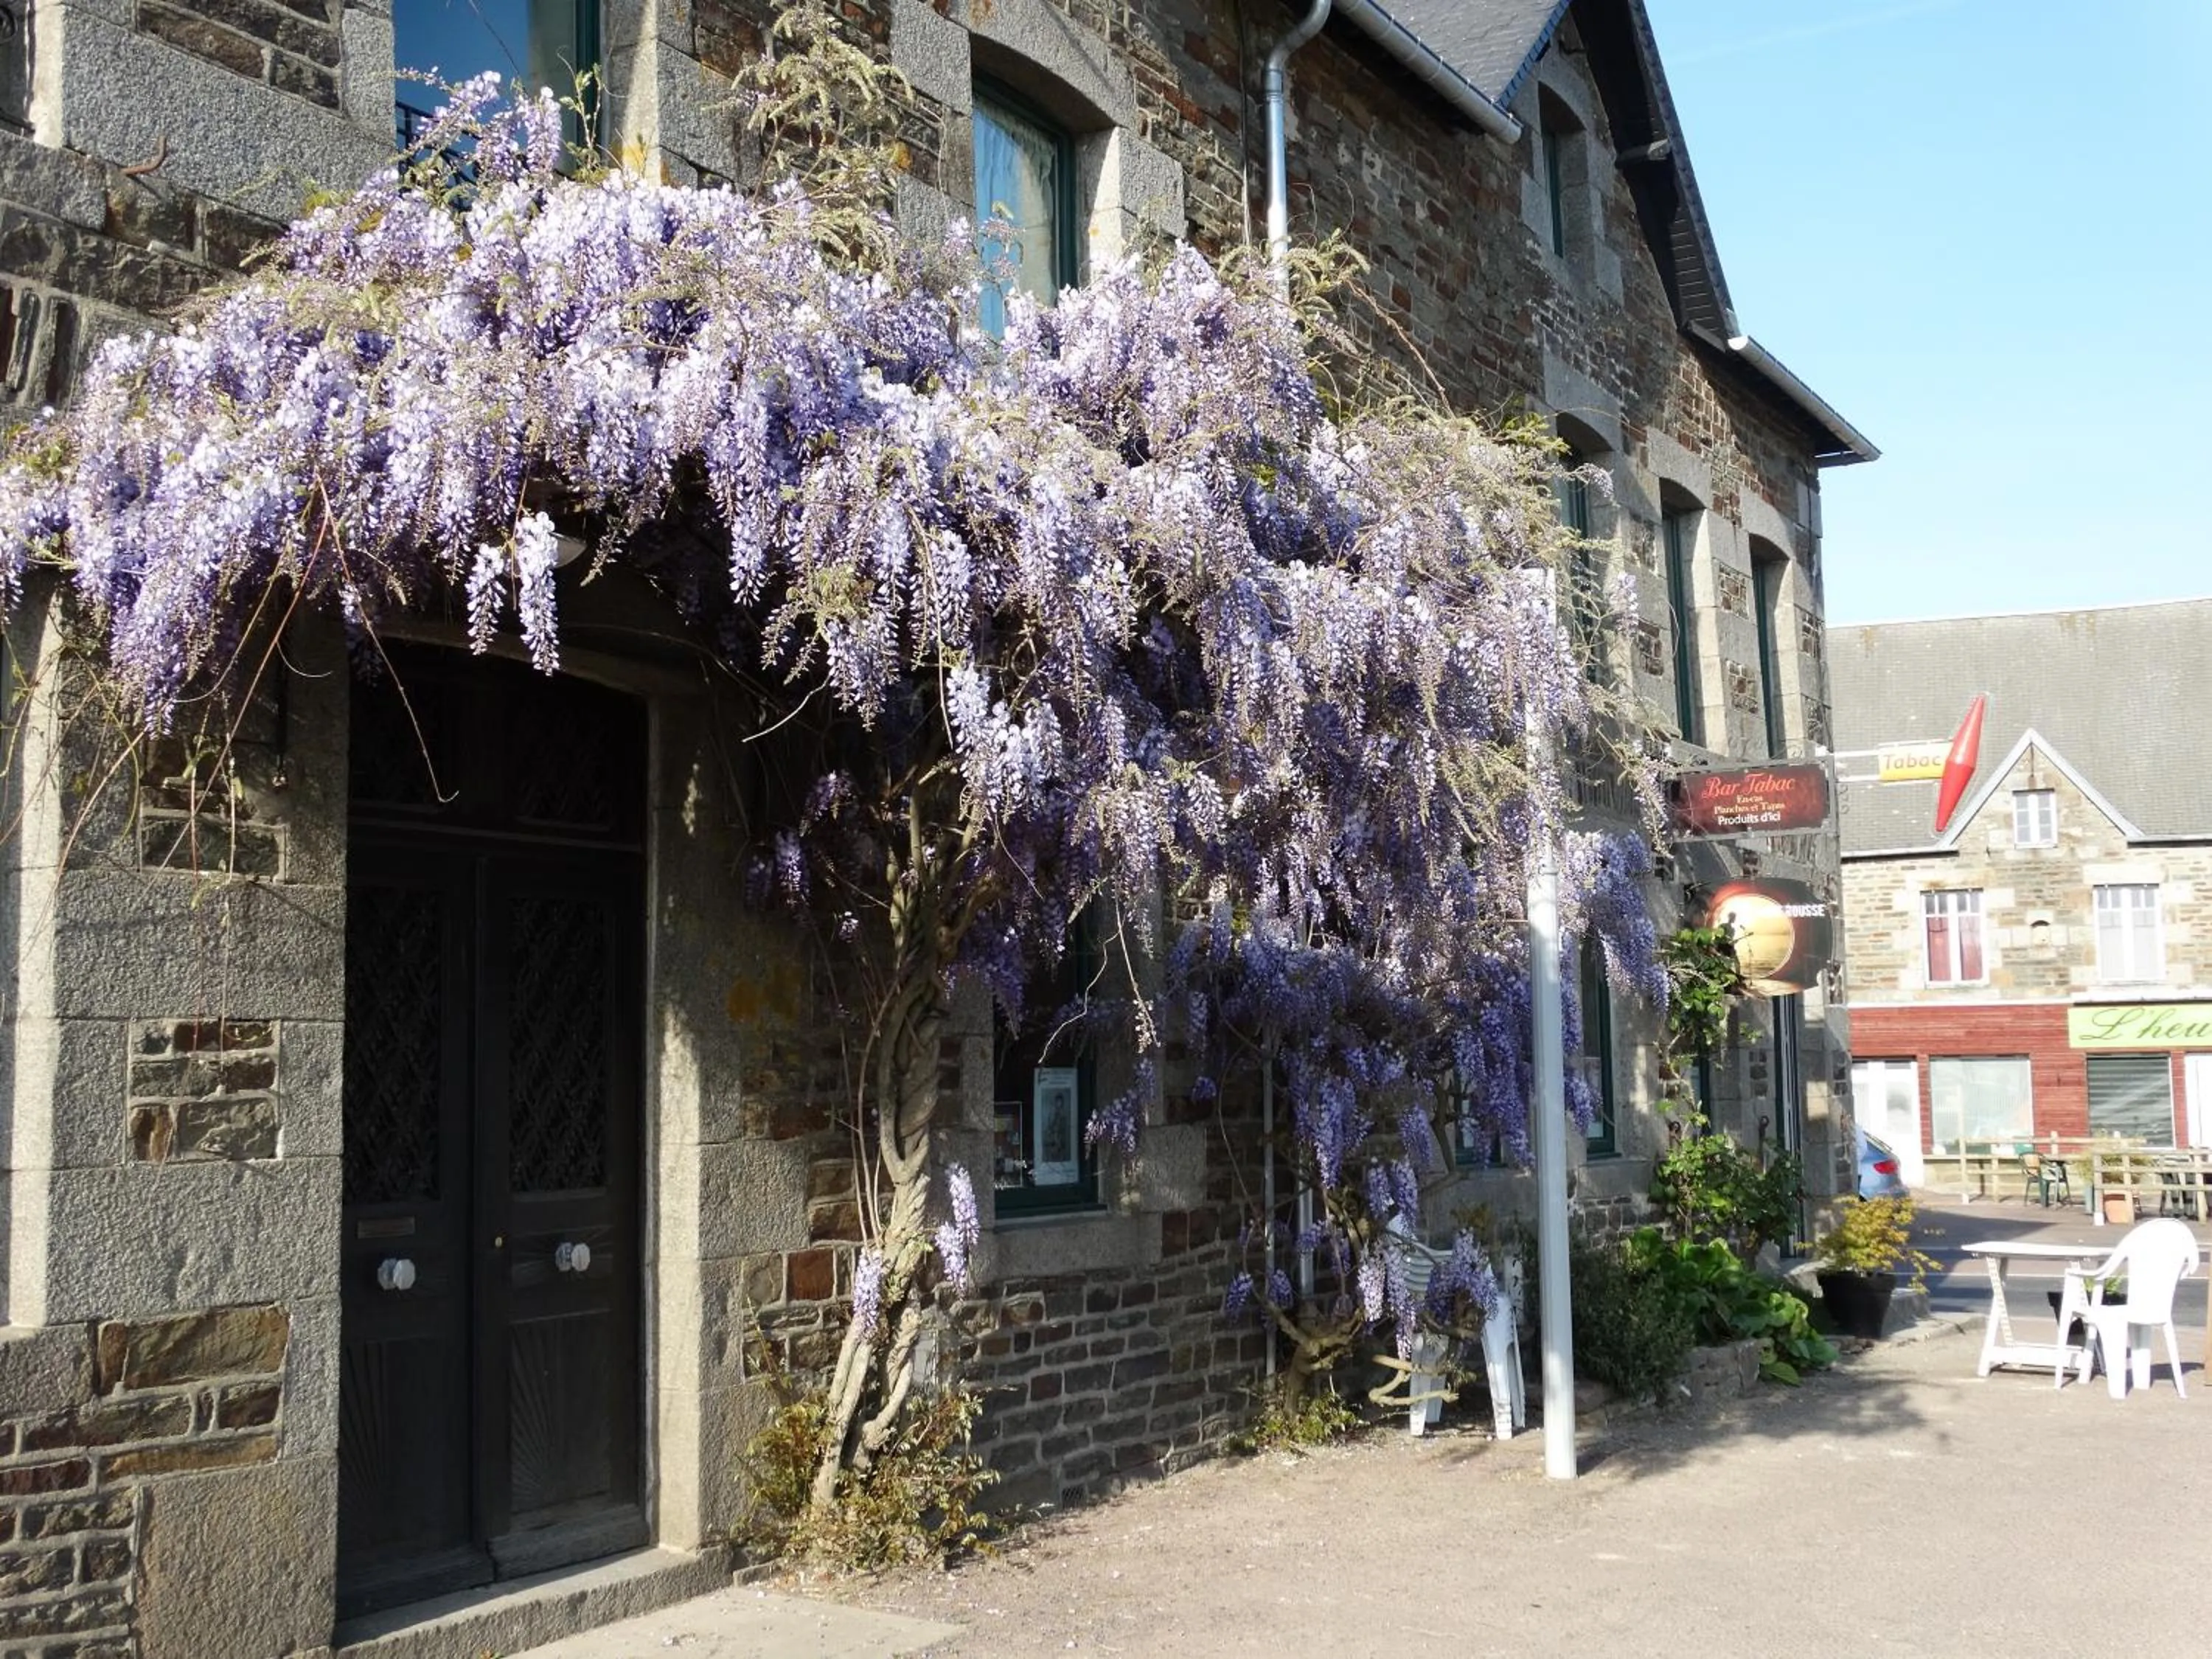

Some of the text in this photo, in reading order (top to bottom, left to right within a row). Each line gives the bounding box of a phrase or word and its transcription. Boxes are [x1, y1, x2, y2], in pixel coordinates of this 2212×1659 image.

[1883, 753, 1941, 771] Tabac
[1702, 772, 1795, 799] Bar Tabac
[1717, 811, 1781, 825] Produits d'ici
